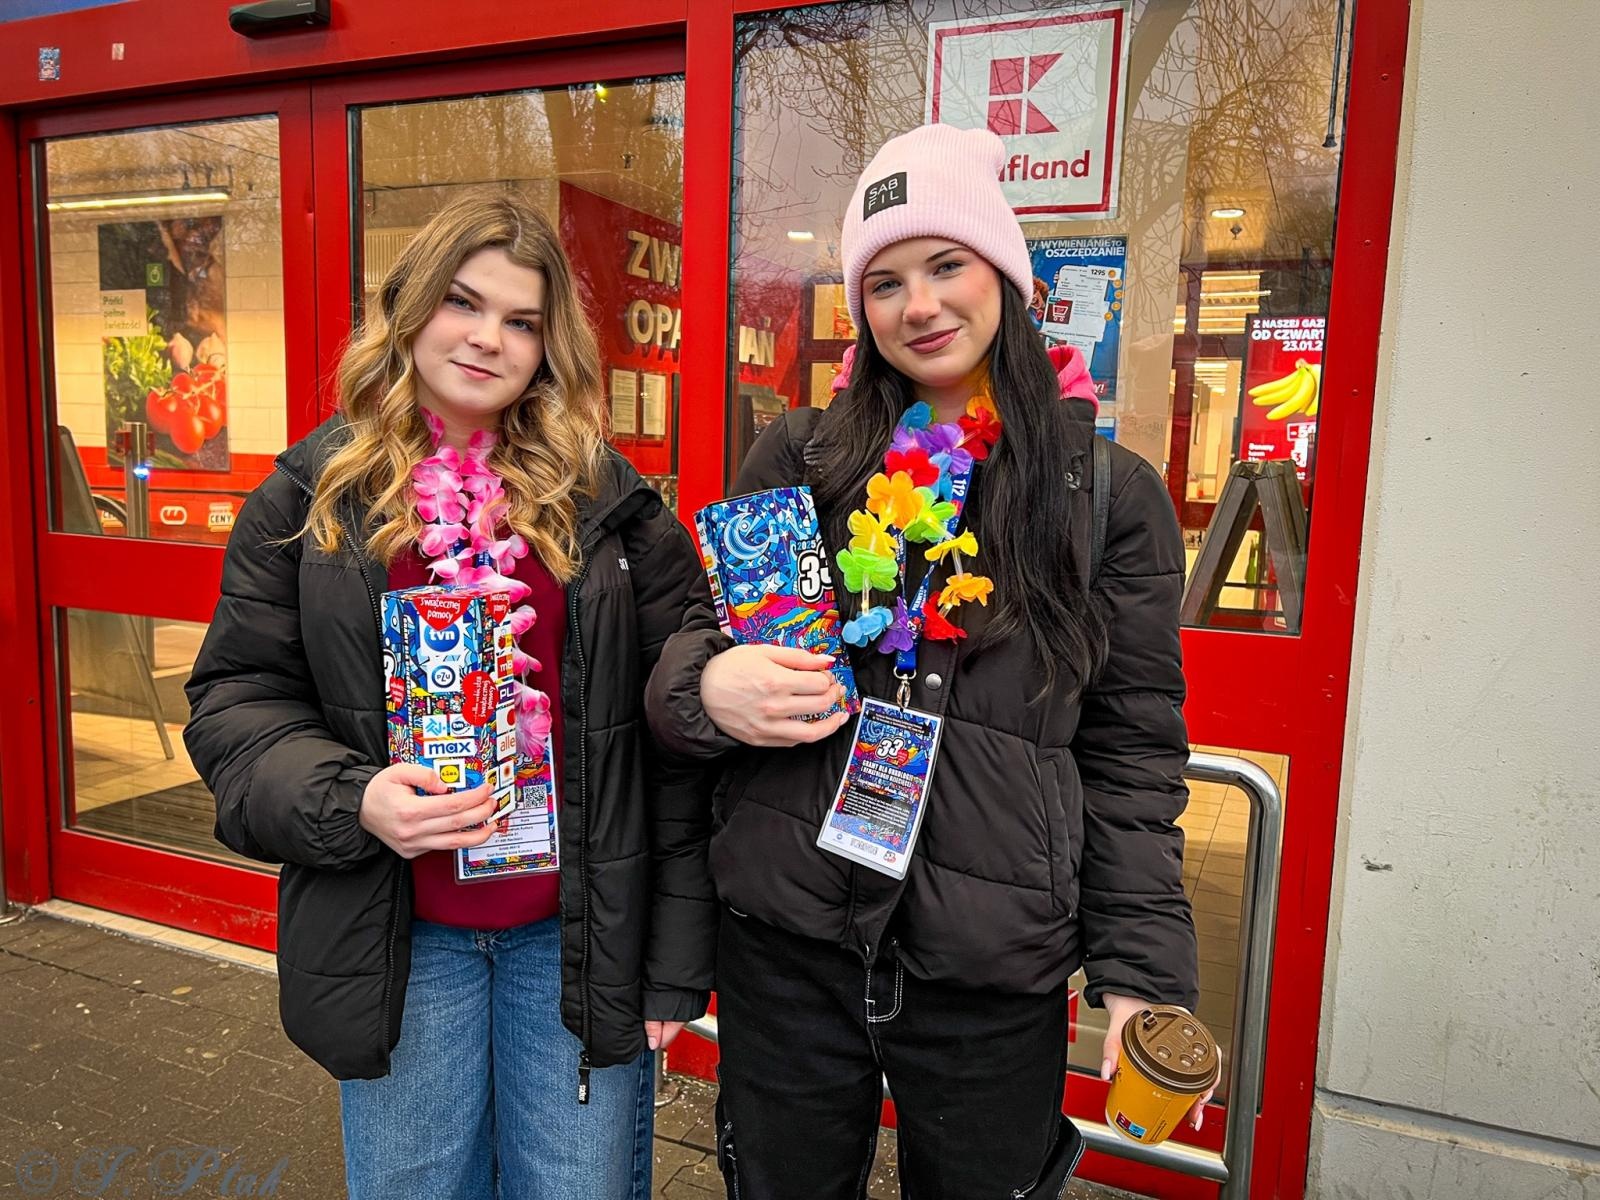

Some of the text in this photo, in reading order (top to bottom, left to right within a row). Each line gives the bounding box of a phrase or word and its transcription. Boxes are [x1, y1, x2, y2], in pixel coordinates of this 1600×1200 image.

[998, 149, 1090, 182] fland
[868, 178, 898, 199] SAB
[1041, 239, 1110, 249] WYMIENIANIE
[1045, 247, 1125, 259] OSZCZĘDZANIE!
[1253, 318, 1325, 328] Z NASZEJ GAZ
[1251, 329, 1271, 340] OD
[1282, 340, 1323, 352] 23.01.2
[951, 478, 967, 497] 112
[210, 514, 231, 523] CENY
[797, 540, 816, 551] 2025
[427, 610, 453, 622] pomocy
[429, 629, 456, 641] tvn
[429, 742, 471, 755] max
[500, 736, 515, 752] alle
